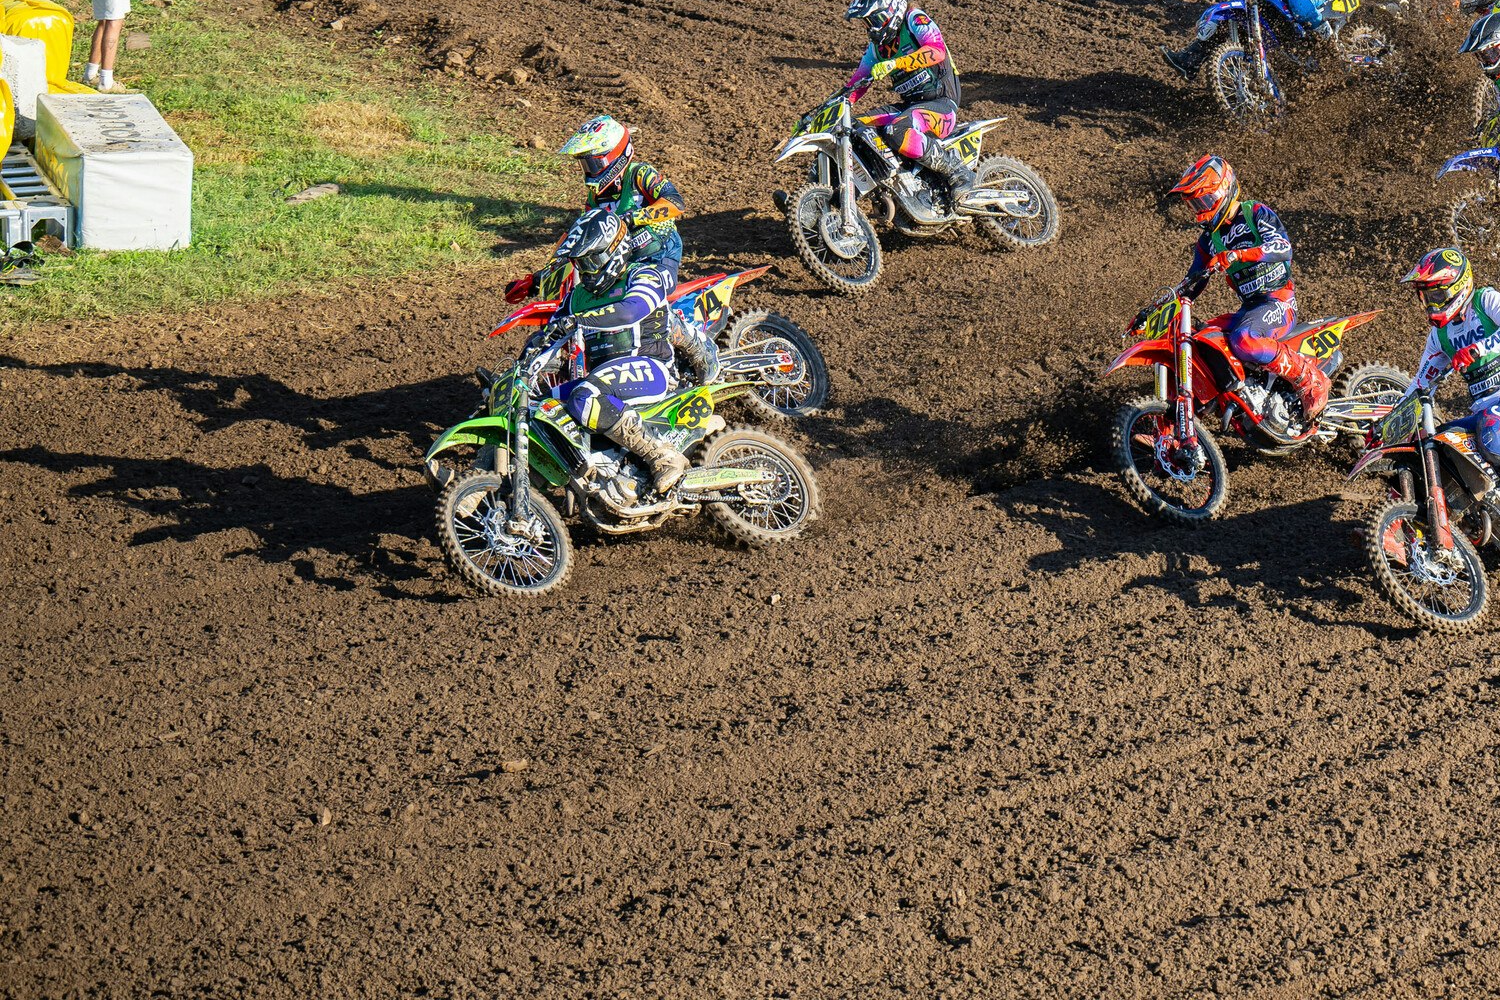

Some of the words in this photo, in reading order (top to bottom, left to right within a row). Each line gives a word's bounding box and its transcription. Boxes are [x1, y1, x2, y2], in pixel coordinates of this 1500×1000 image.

[693, 291, 723, 321] 14
[1307, 329, 1339, 357] 90
[1449, 326, 1485, 351] ANVAS
[590, 359, 656, 385] FXR
[678, 395, 713, 428] 38
